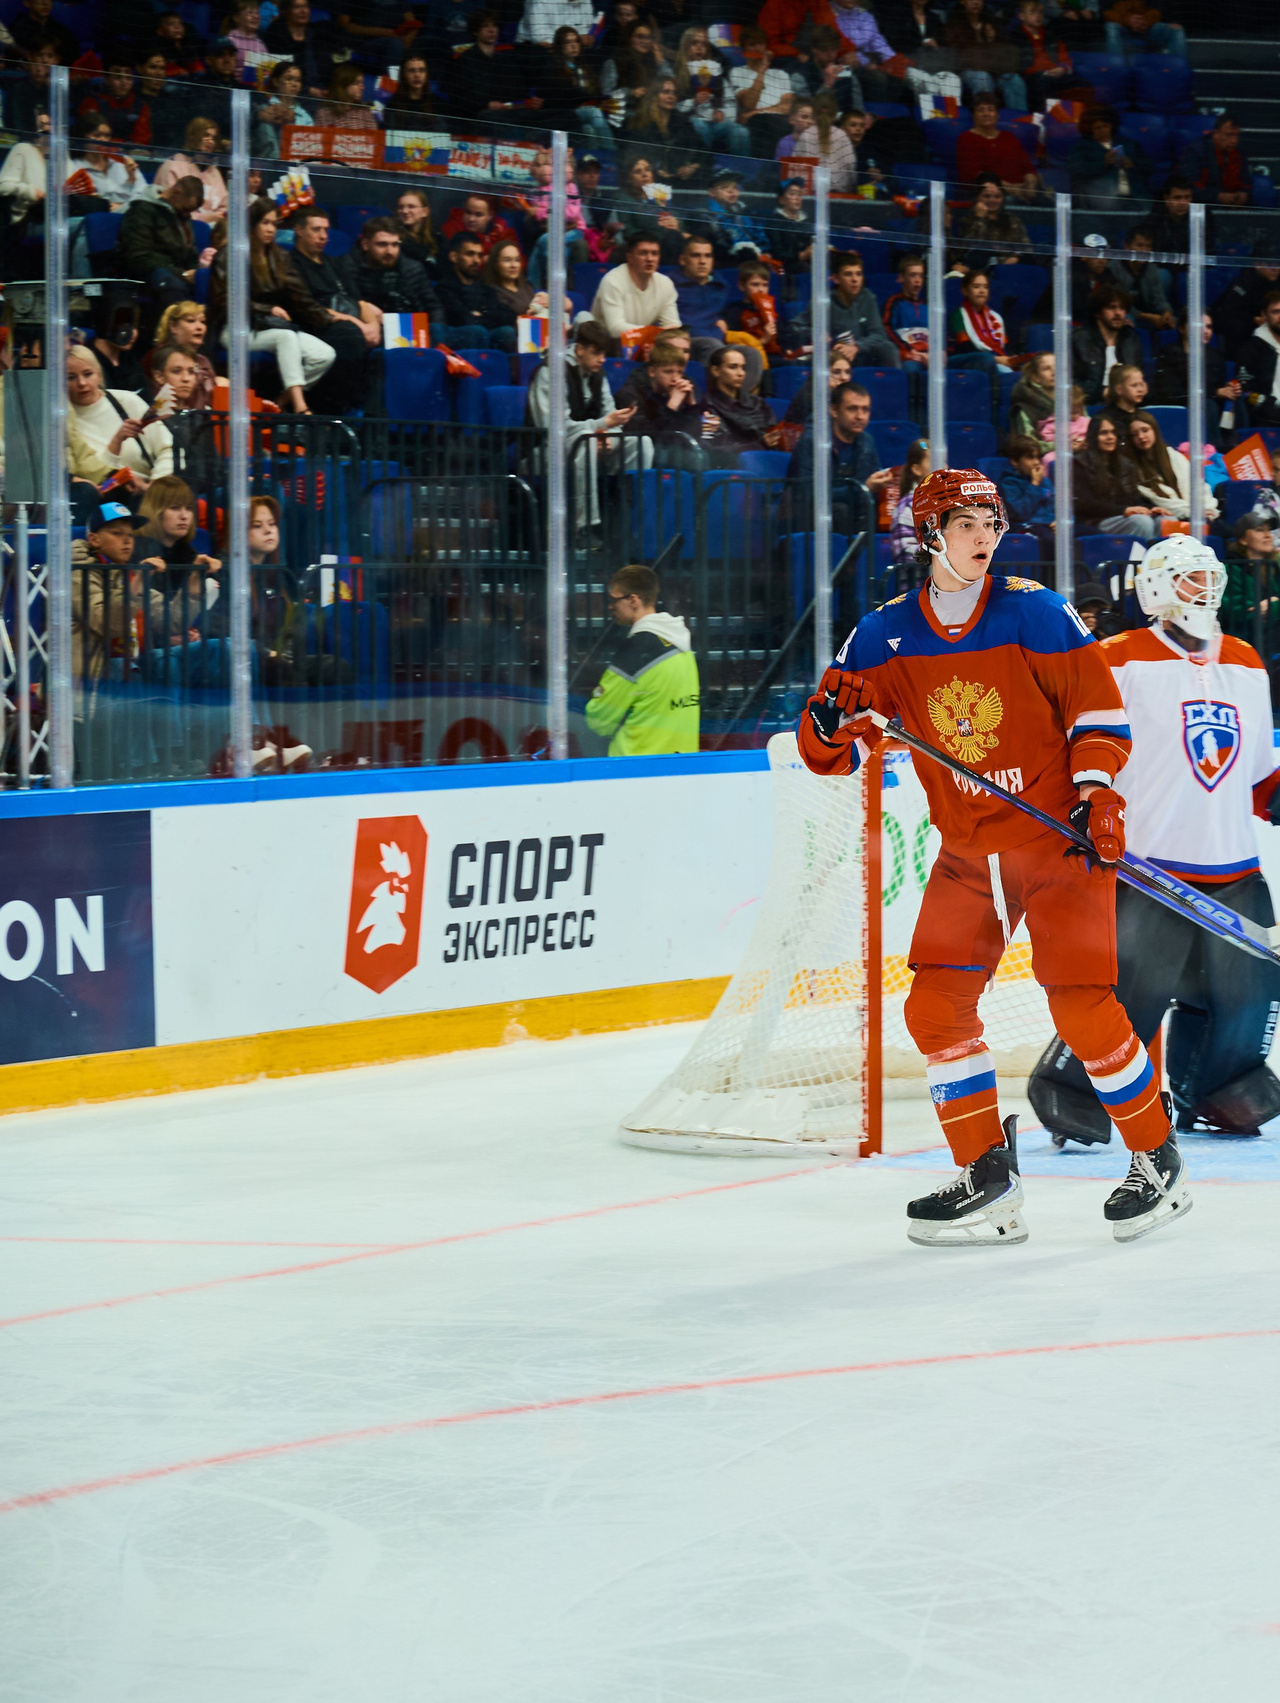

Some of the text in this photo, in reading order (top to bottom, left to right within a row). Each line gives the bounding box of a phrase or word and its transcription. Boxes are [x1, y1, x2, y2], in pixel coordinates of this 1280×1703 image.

[962, 484, 995, 493] РОЛЬФ
[1070, 805, 1084, 820] CCM
[448, 833, 604, 909] СПОРТ
[443, 909, 596, 964] ЭКСПРЕСС
[955, 1190, 985, 1210] BAUER
